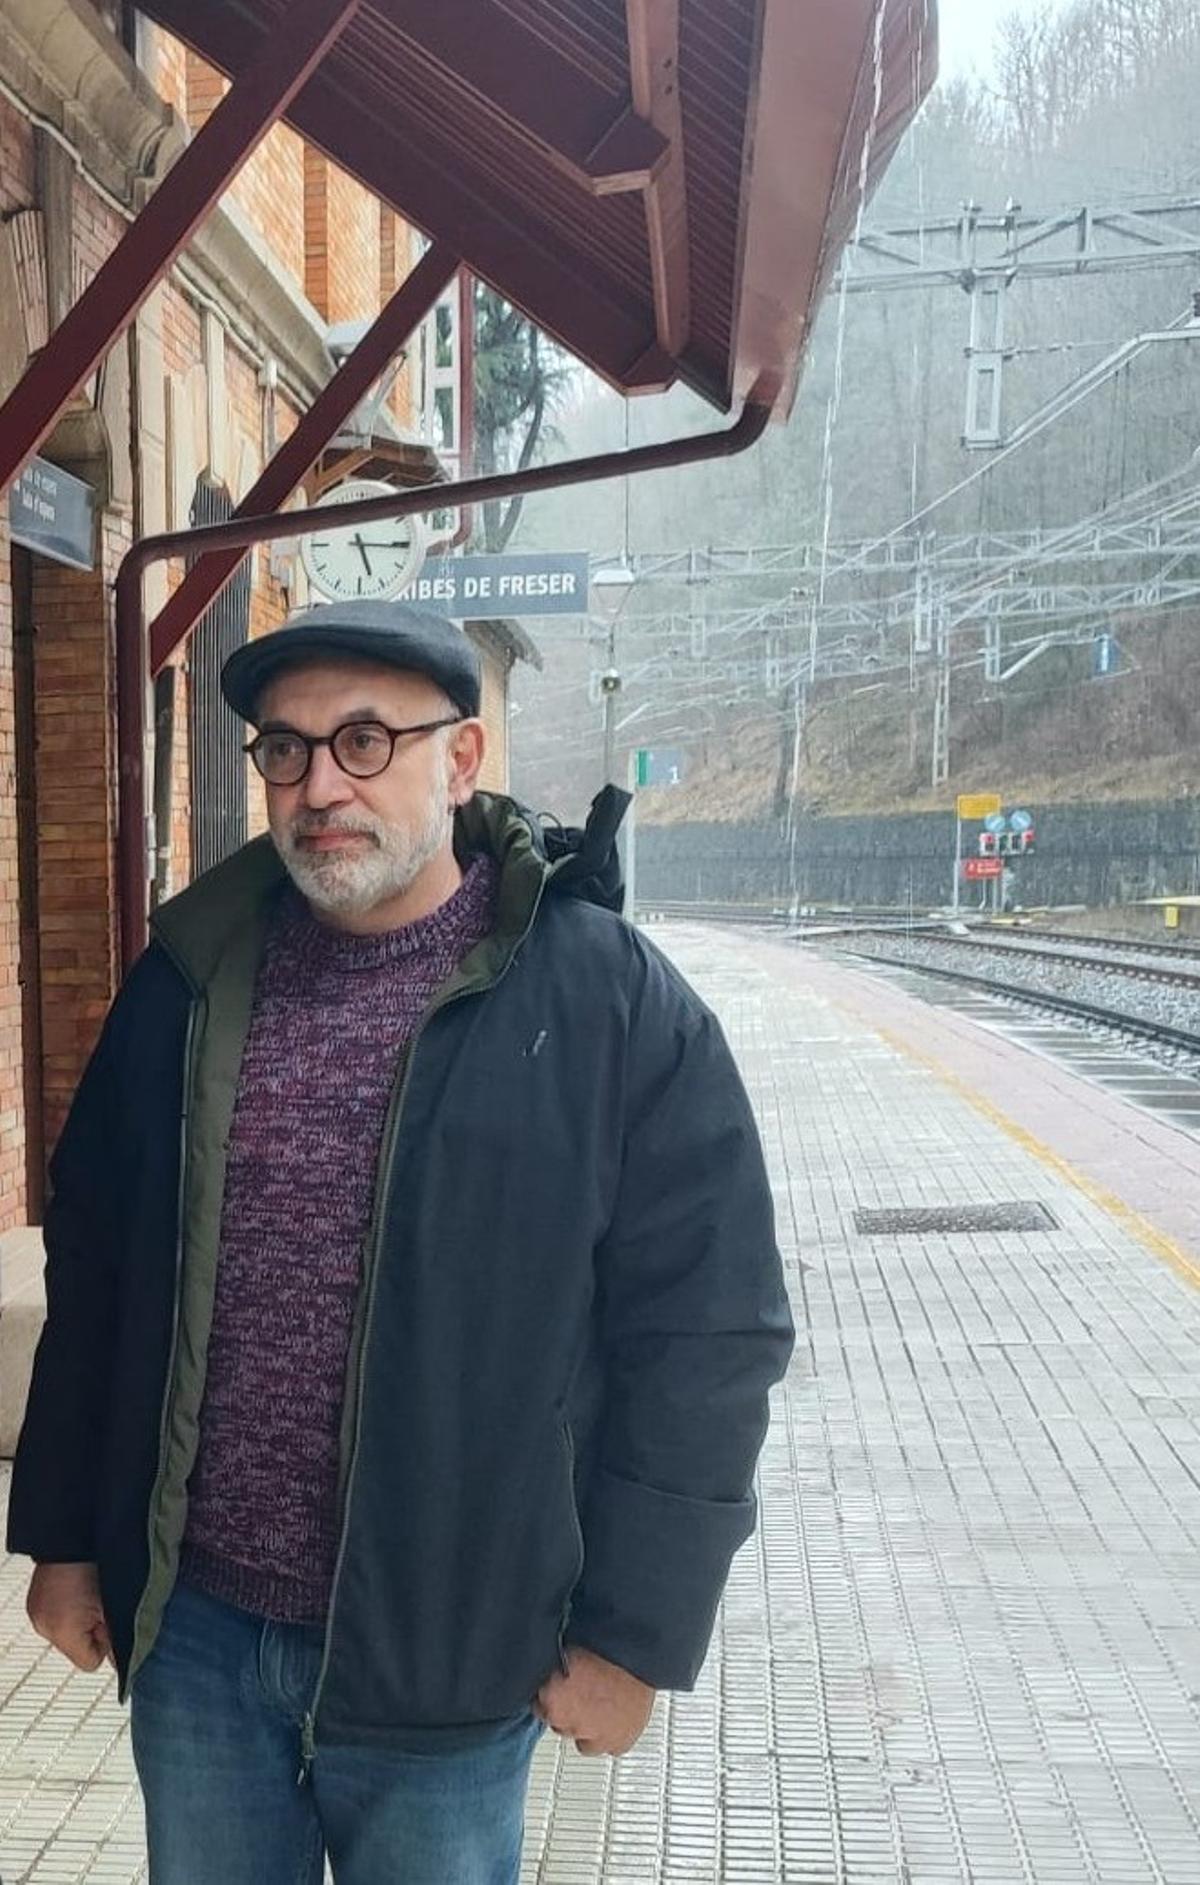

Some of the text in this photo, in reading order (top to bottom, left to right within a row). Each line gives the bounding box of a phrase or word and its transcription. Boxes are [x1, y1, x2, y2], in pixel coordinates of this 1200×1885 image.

[464, 577, 491, 599] DE
[499, 573, 576, 596] FRESER
[670, 765, 680, 785] 1
